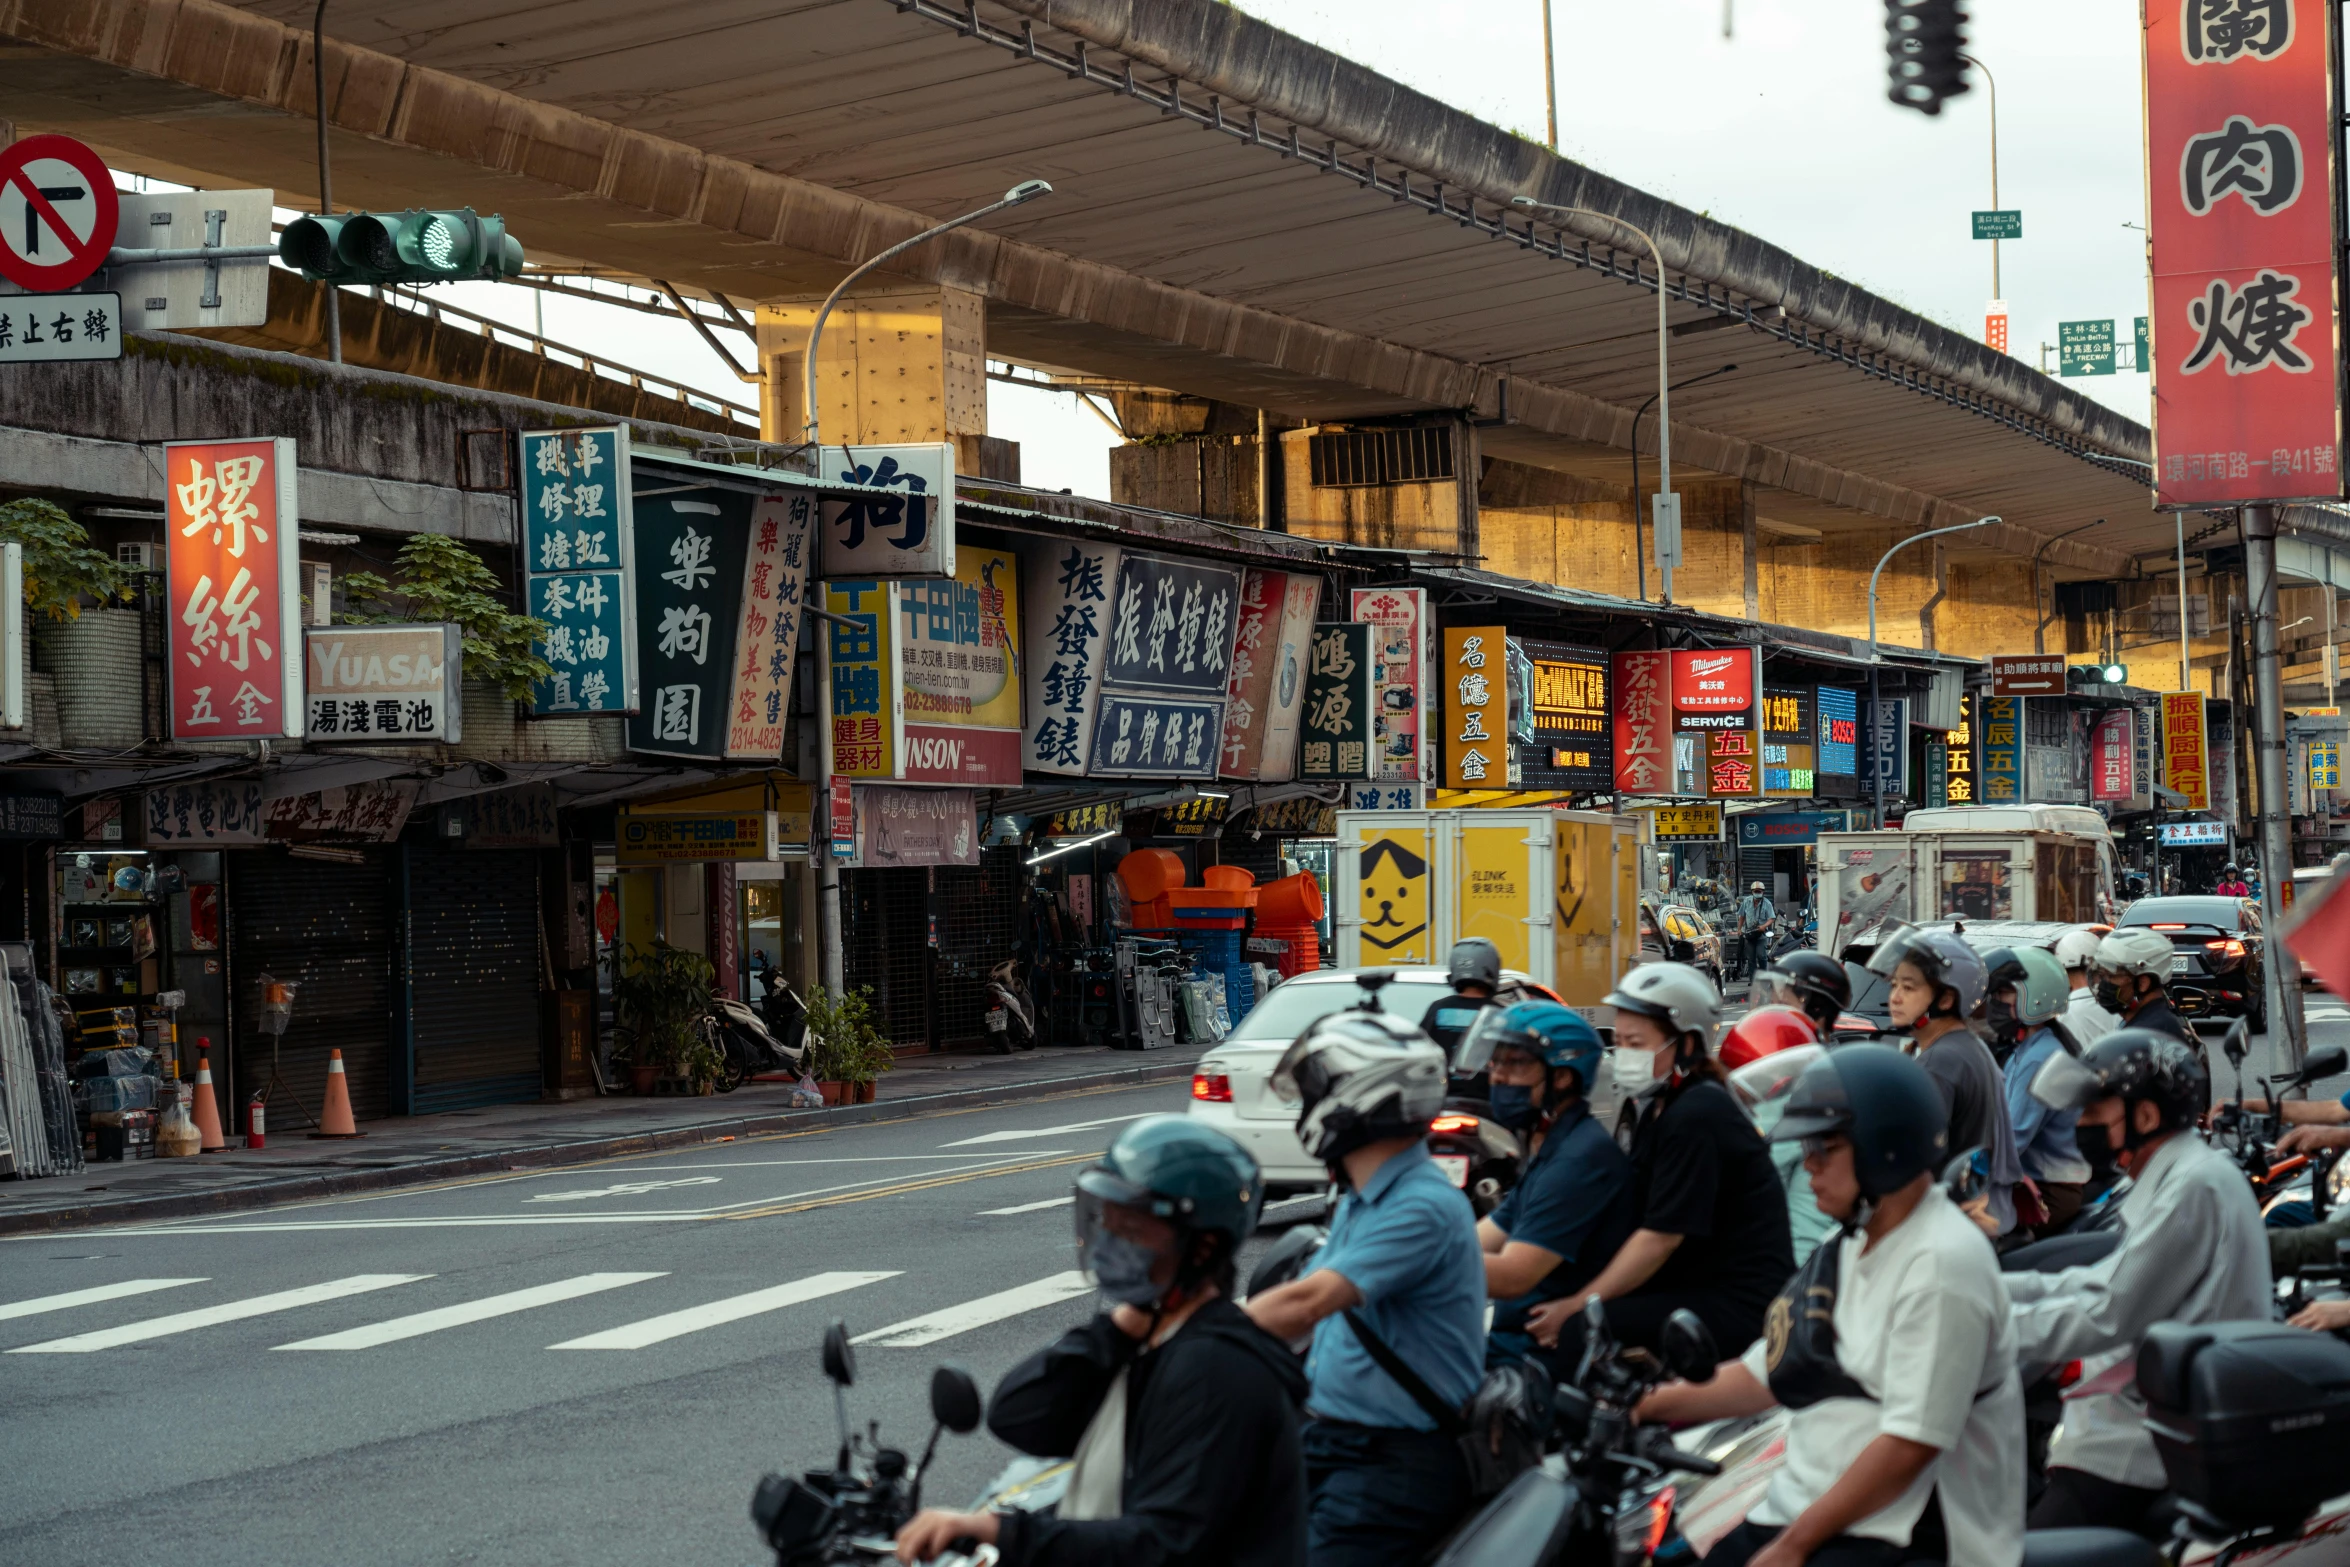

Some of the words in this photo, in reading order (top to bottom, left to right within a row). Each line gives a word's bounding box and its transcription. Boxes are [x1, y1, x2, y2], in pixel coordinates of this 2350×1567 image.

[2074, 343, 2112, 354] 高速公路
[536, 434, 603, 478] 機車
[2165, 446, 2335, 482] 環河南路一段41號
[539, 483, 607, 523] 修理
[835, 456, 928, 550] 狗
[176, 455, 273, 672] 螺絲
[543, 576, 609, 620] 零件
[980, 586, 1006, 615] 健身
[653, 500, 721, 746] 一樂狗園
[980, 620, 1006, 649] 器材
[1114, 571, 1229, 675] 振發鐘錶
[545, 624, 610, 665] 機油
[1034, 546, 1107, 768] 振發鐘錶
[311, 641, 444, 687] YUASA
[1690, 656, 1734, 674] Milwaukee
[2004, 662, 2063, 675] 助順將軍廟
[548, 668, 611, 712] 直營
[1699, 681, 1726, 690] 美沃奇
[186, 681, 273, 727] 五金
[311, 700, 434, 733] 湯淺電池
[1459, 635, 1491, 781] 名億五金
[1681, 715, 1745, 728] SERVICE
[730, 725, 782, 751] 2314-4825
[834, 717, 883, 744] 健身
[1622, 655, 1664, 790] 宏發五金
[1832, 719, 1855, 744] BOSCH
[835, 745, 883, 771] 器材
[1304, 741, 1365, 774] 塑膠
[1711, 730, 1754, 793] 五金
[1986, 697, 2017, 800] 名辰五金
[2104, 728, 2121, 792] 勝利五金
[2311, 753, 2338, 768] 鋼索
[2312, 771, 2338, 787] 吊車
[1682, 811, 1715, 822] 史丹利
[1765, 824, 1809, 835] BOSCH
